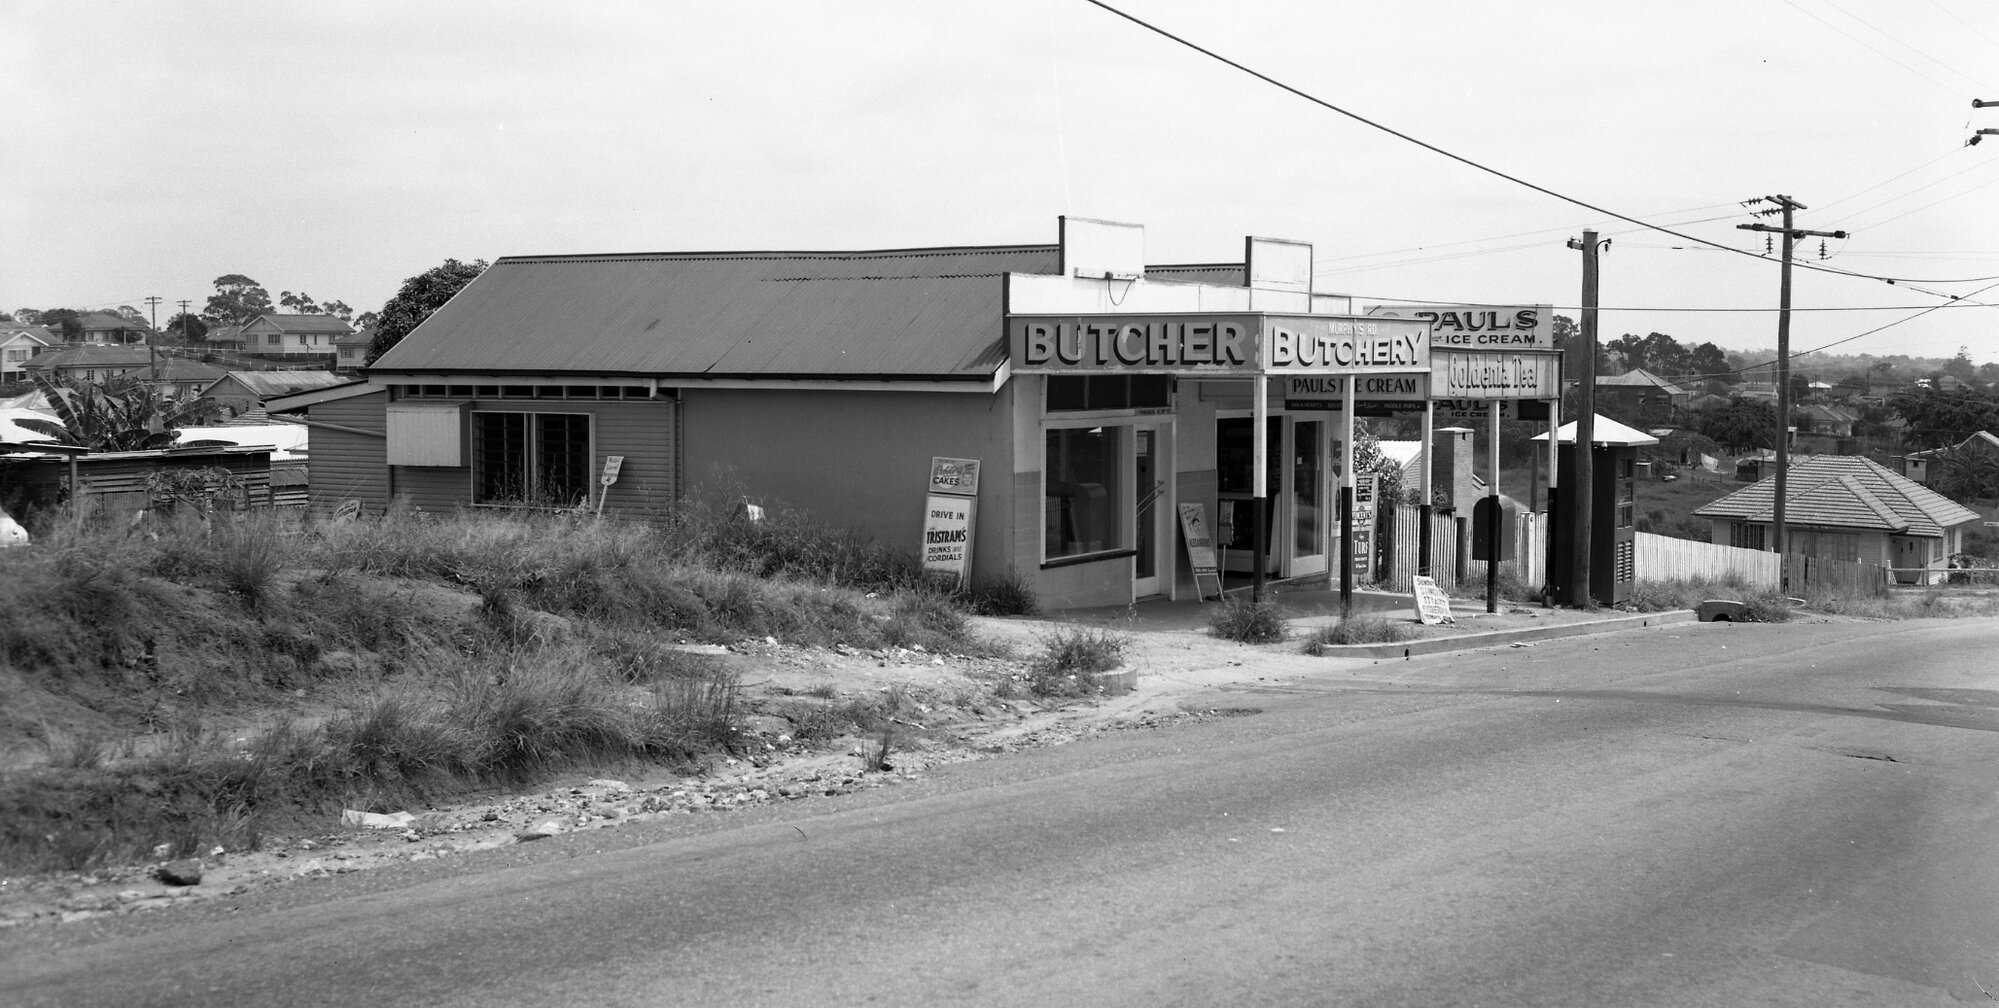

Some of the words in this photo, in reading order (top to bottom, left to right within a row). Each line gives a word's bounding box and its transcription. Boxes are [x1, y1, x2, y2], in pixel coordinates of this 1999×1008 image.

[1025, 321, 1247, 366] BUTCHER
[1446, 334, 1471, 344] ICE
[1478, 334, 1543, 344] CREAM.
[1272, 325, 1425, 367] BUTCHERY
[1511, 354, 1538, 389] Tea
[1293, 377, 1337, 393] PAULS
[1340, 378, 1362, 393] IE
[1367, 377, 1417, 393] CREAM
[932, 476, 960, 486] CAKES
[930, 510, 954, 520] DRIVE
[956, 512, 965, 521] IN
[928, 545, 952, 555] DRINKS
[1354, 539, 1369, 555] TURF
[927, 553, 962, 563] CORDIALS
